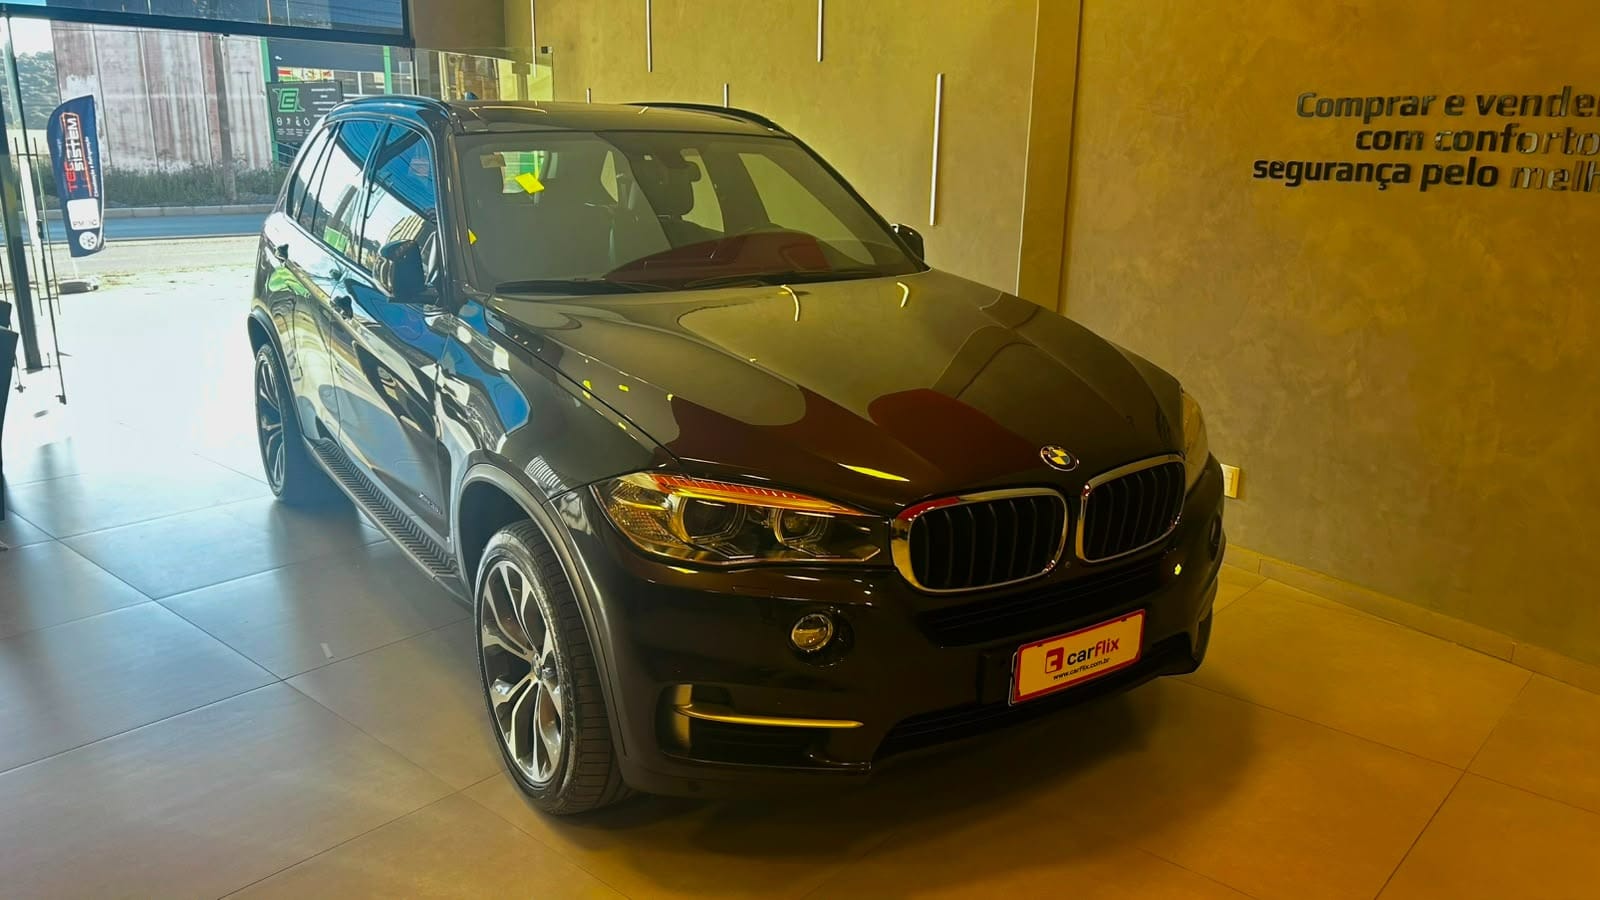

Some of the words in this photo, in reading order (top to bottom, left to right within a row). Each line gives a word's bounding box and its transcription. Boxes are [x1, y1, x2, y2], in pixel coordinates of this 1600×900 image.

[1296, 92, 1436, 124] Comprar
[1444, 94, 1465, 117] e
[66, 117, 85, 171] SISTEM
[1355, 129, 1424, 152] com
[1434, 122, 1600, 155] conforto
[1253, 158, 1411, 191] segurança
[1420, 156, 1499, 192] pelo
[1067, 638, 1120, 665] carflix
[1053, 657, 1110, 680] www.carflix.com.br
